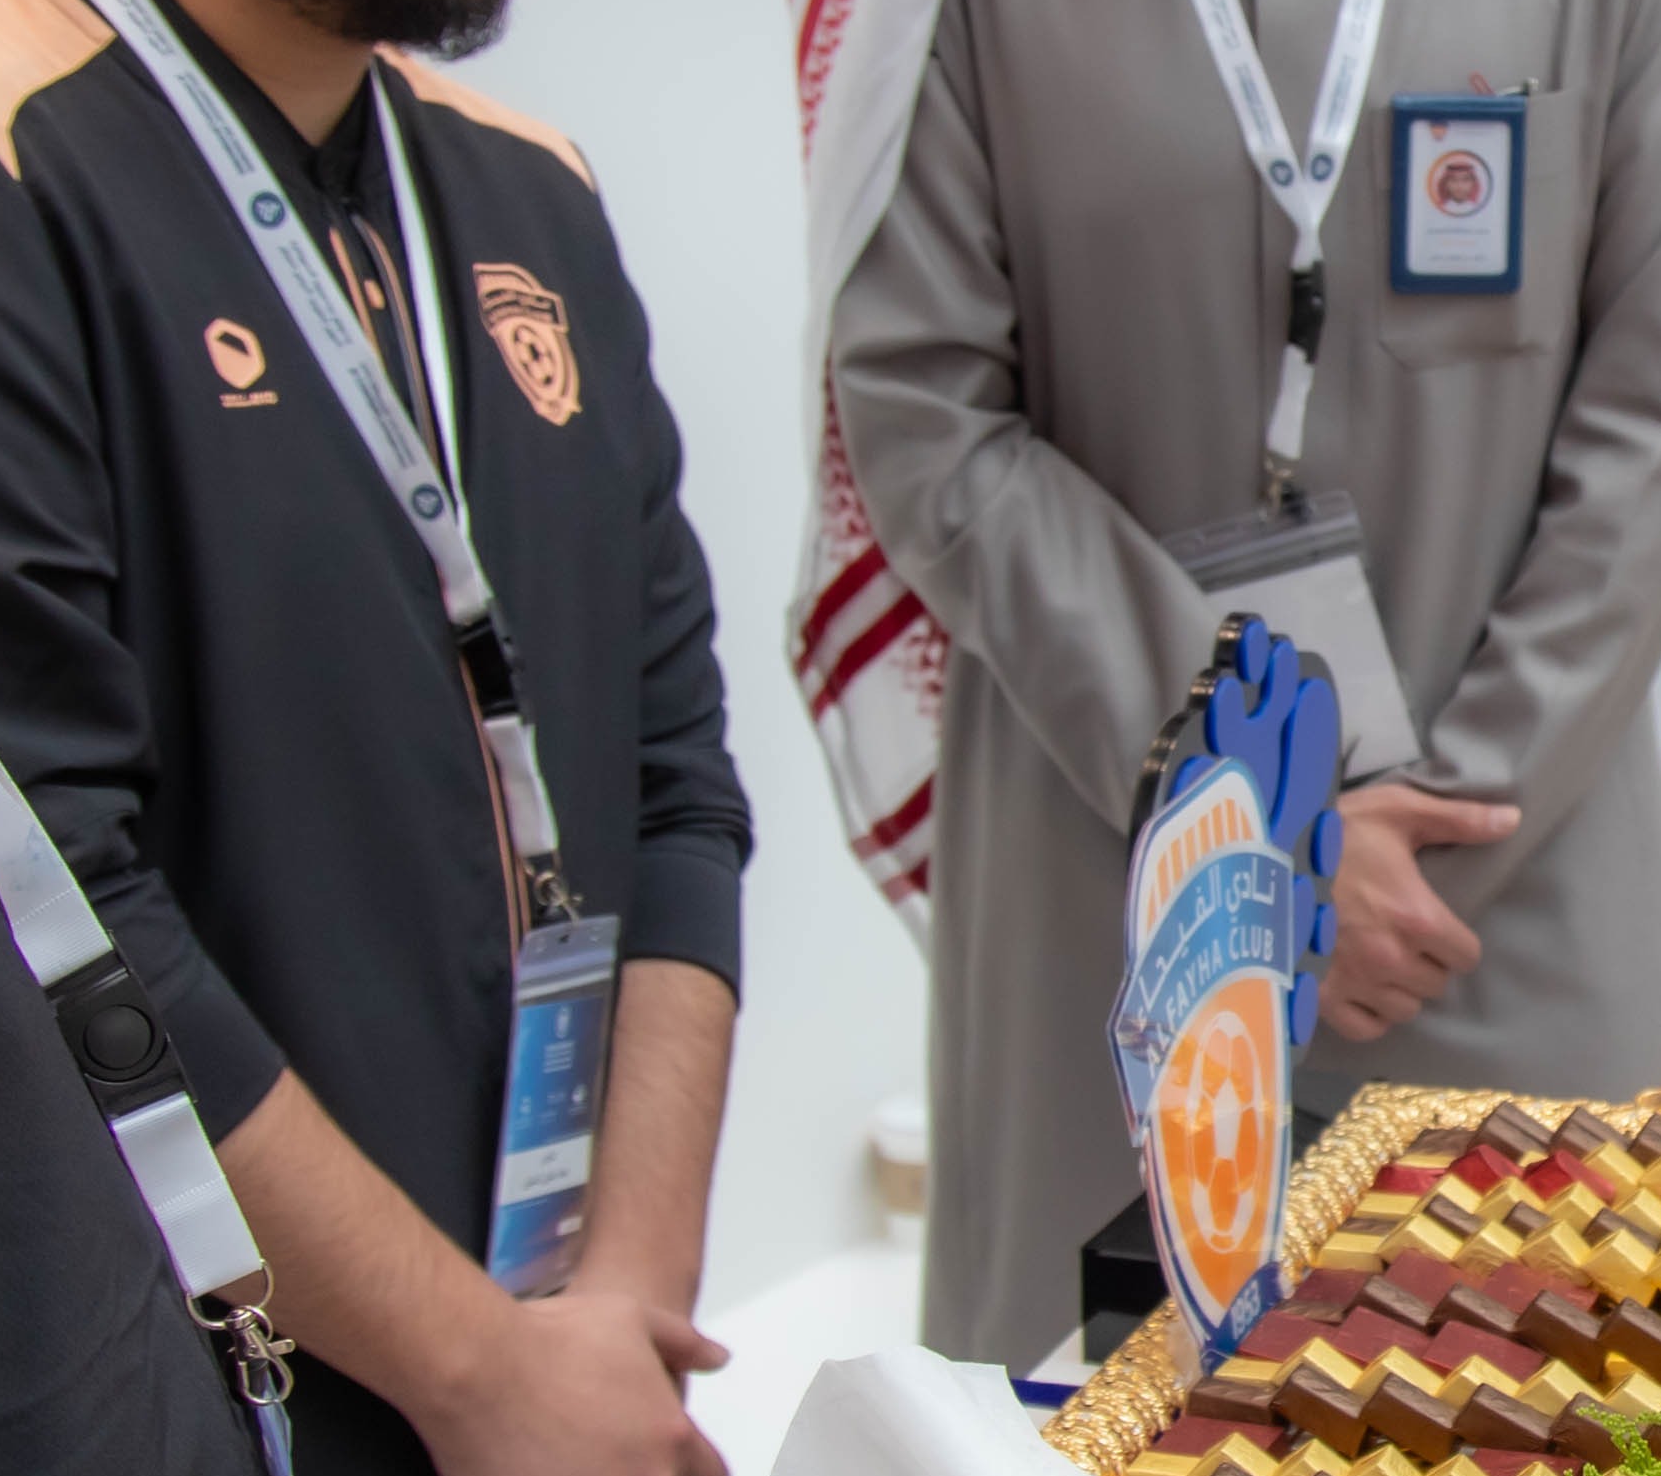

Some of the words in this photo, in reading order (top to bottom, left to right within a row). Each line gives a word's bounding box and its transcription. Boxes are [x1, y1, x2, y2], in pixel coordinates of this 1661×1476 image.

[1225, 856, 1276, 924] نادي
[1166, 938, 1224, 1035] FAYHA
[1228, 924, 1275, 963] CLUB
